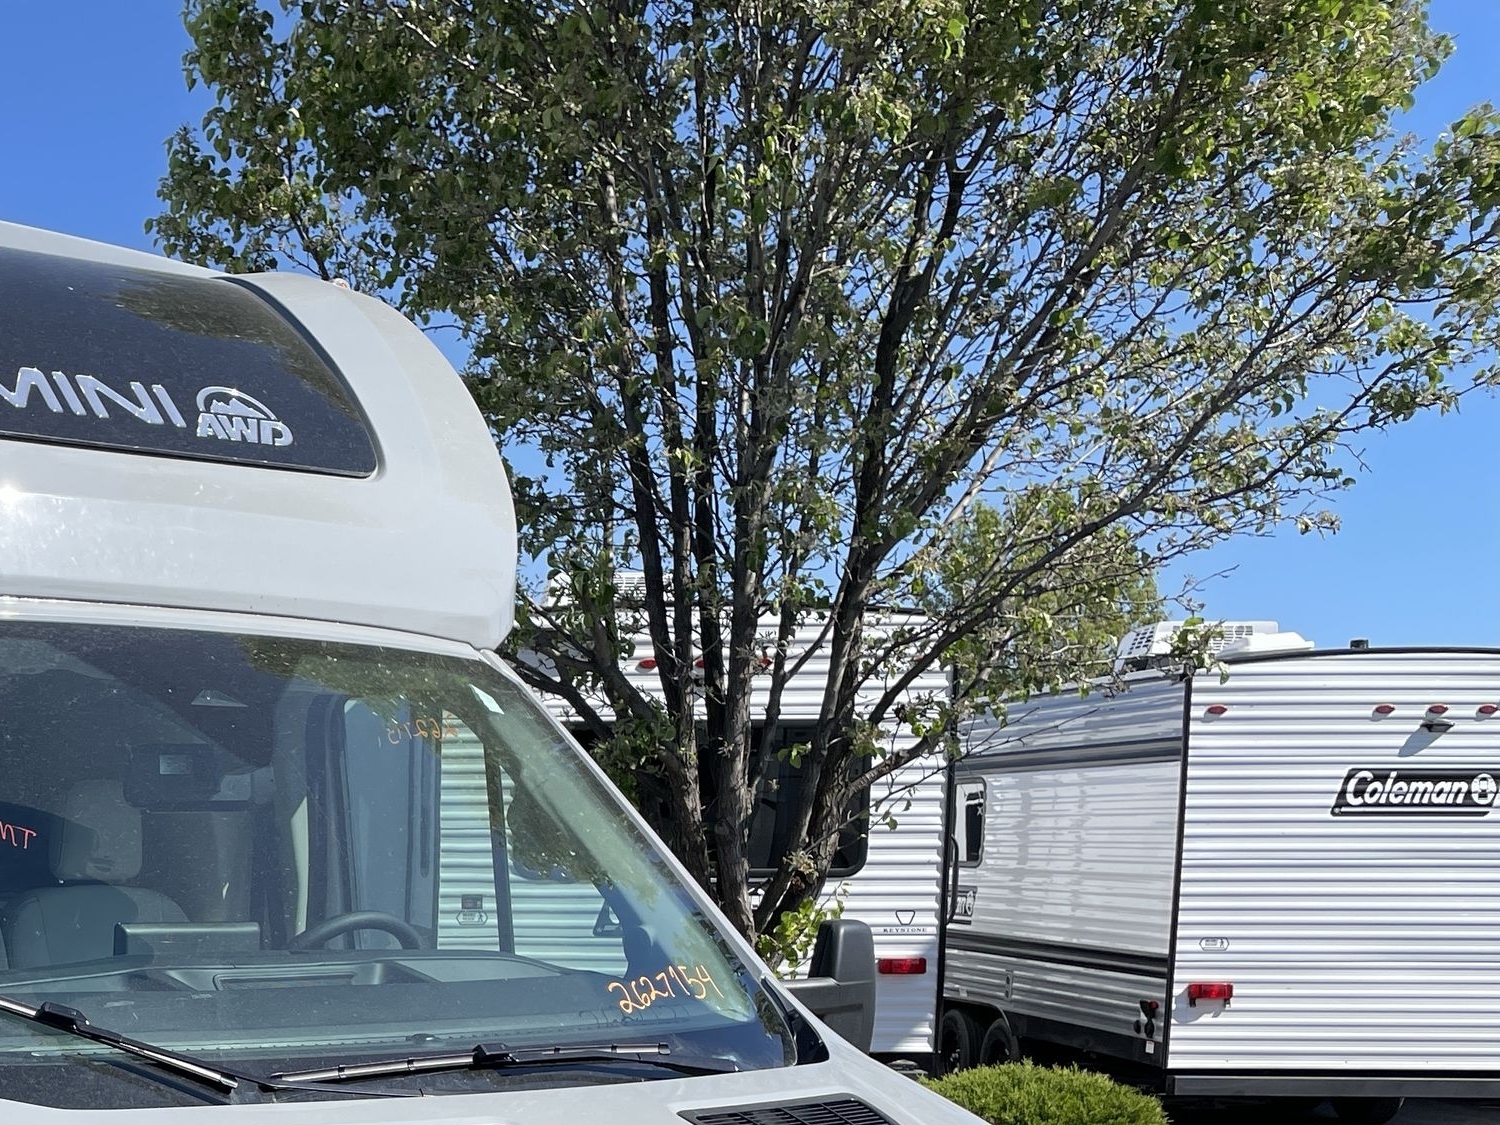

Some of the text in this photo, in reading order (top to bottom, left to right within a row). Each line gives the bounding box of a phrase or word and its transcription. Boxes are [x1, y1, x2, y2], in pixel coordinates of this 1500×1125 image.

[196, 412, 294, 447] AWD
[1345, 770, 1469, 806] Coleman
[607, 964, 725, 1014] 2627154
